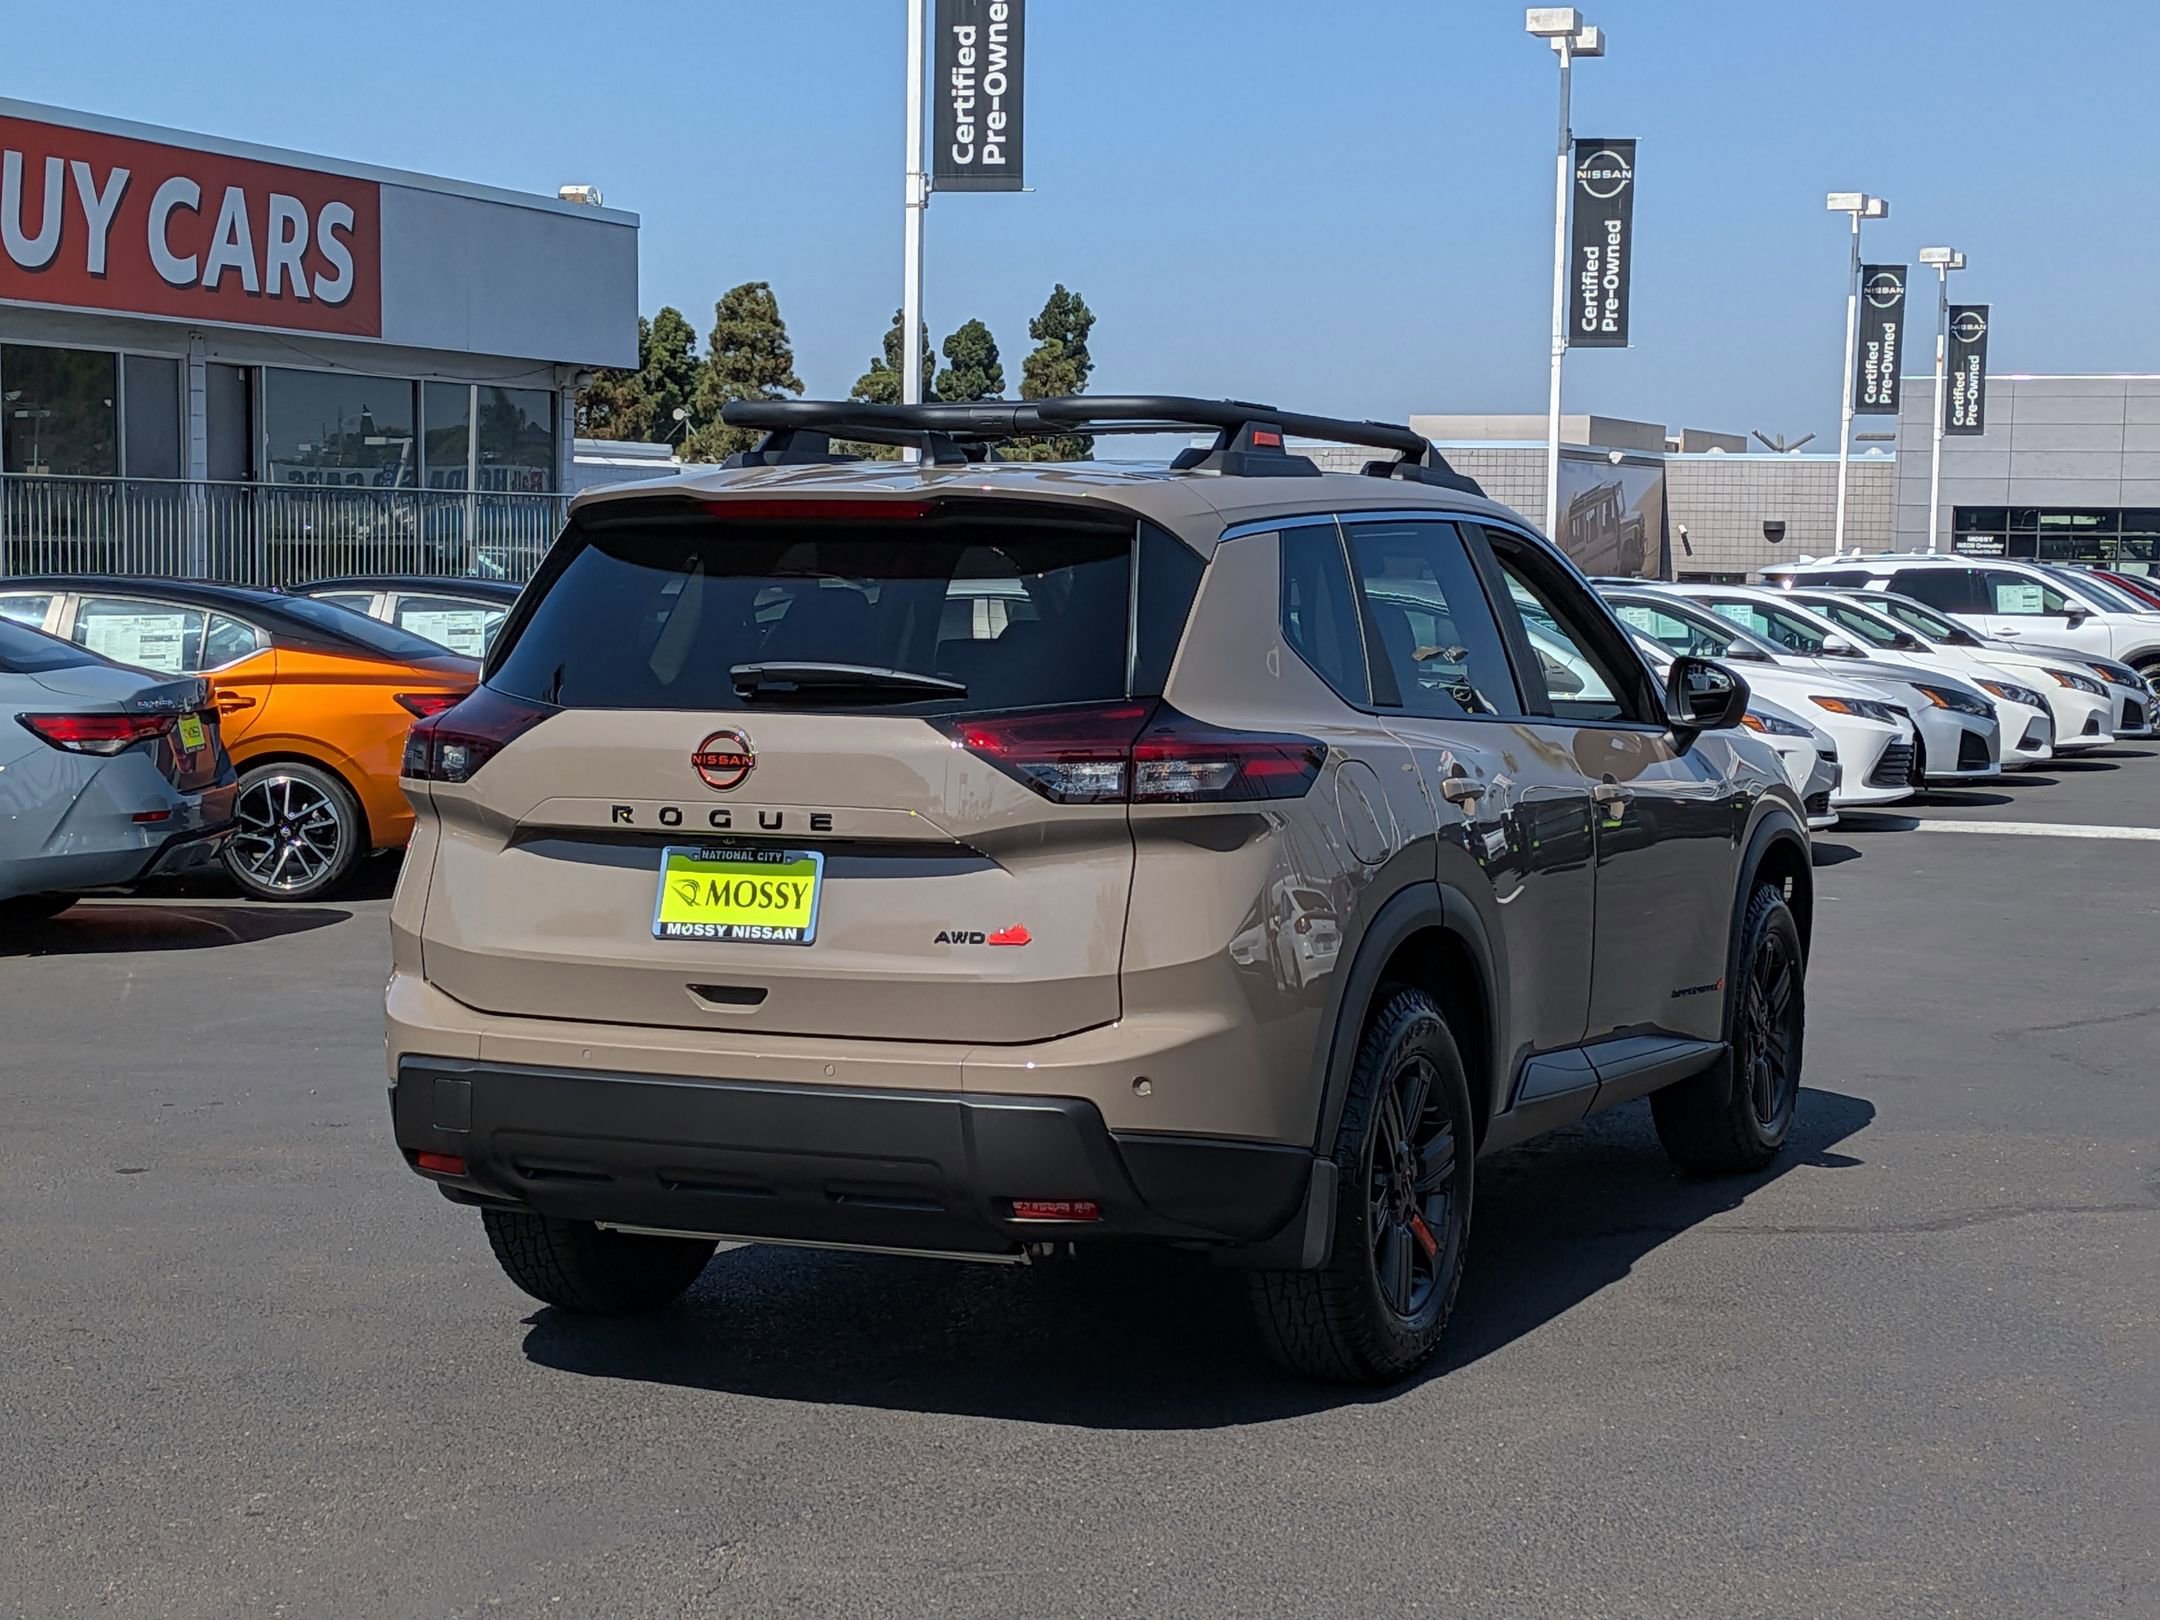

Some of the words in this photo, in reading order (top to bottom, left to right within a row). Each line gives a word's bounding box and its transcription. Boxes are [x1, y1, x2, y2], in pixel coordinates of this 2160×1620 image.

[951, 25, 977, 165] Certified
[982, 0, 1009, 165] Pre-Owne
[1576, 170, 1632, 179] NISSAN
[147, 176, 355, 303] CARS
[1581, 246, 1600, 332] Certified
[1601, 219, 1622, 332] Pre-Owned
[1864, 341, 1880, 404] Certified
[1879, 322, 1896, 404] Pre-Owned
[1966, 355, 1980, 426] Pre-Owned
[1953, 371, 1966, 426] Certified
[692, 753, 753, 766] NISSAN
[611, 805, 833, 832] ROGUE
[701, 849, 755, 861] NATIONAL
[756, 851, 783, 862] CITY
[705, 879, 809, 910] MOSSY
[666, 923, 728, 938] MOSSY
[732, 925, 798, 941] NISSAN
[933, 931, 986, 945] AWD
